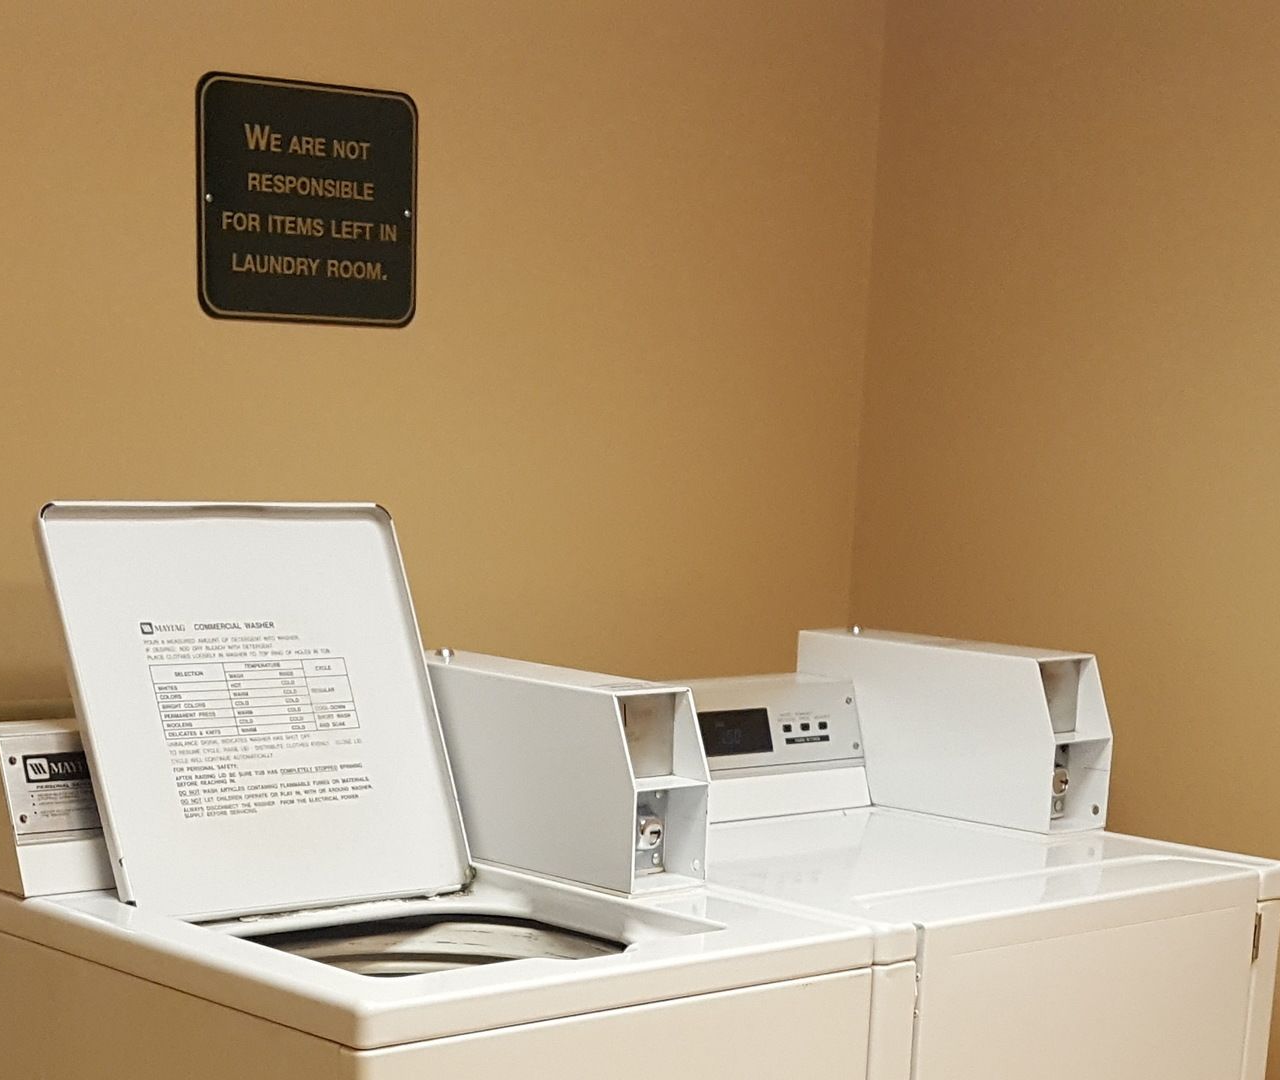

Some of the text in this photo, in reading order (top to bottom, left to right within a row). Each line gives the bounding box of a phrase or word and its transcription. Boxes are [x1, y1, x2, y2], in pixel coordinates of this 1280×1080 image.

[244, 123, 370, 160] WE ARE NOT
[247, 172, 374, 201] RESPONSIBLE
[222, 211, 397, 242] FOR ITEMS LEFT IN
[232, 253, 388, 281] LAUNDRY ROOM.
[154, 621, 275, 632] MAYTAG COMMERCIAL WASHER
